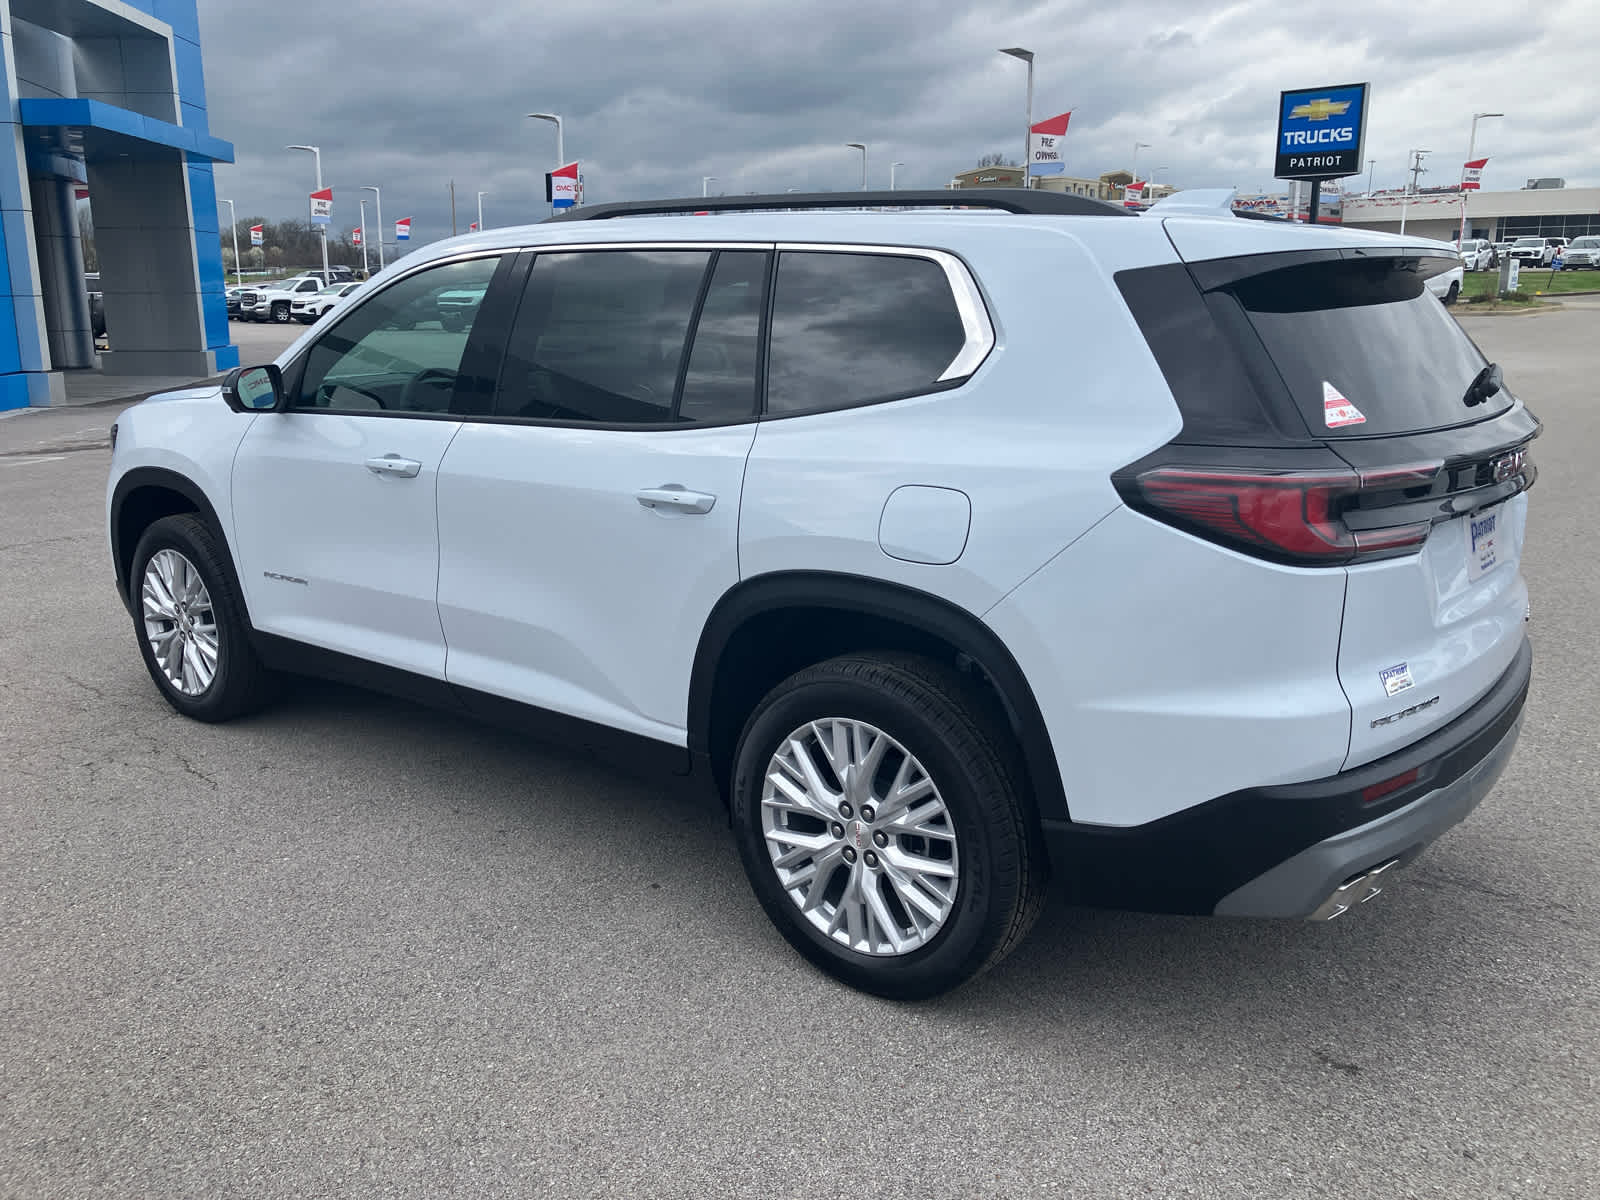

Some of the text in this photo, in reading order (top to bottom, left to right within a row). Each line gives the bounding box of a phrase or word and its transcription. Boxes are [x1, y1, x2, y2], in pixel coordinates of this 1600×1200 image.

[1041, 137, 1055, 148] PRE
[1284, 127, 1353, 145] TRUCKS
[1290, 156, 1342, 168] PATRIOT
[555, 184, 572, 192] GMC
[1470, 514, 1496, 553] PATRIOT
[1382, 665, 1408, 685] PATRIOT
